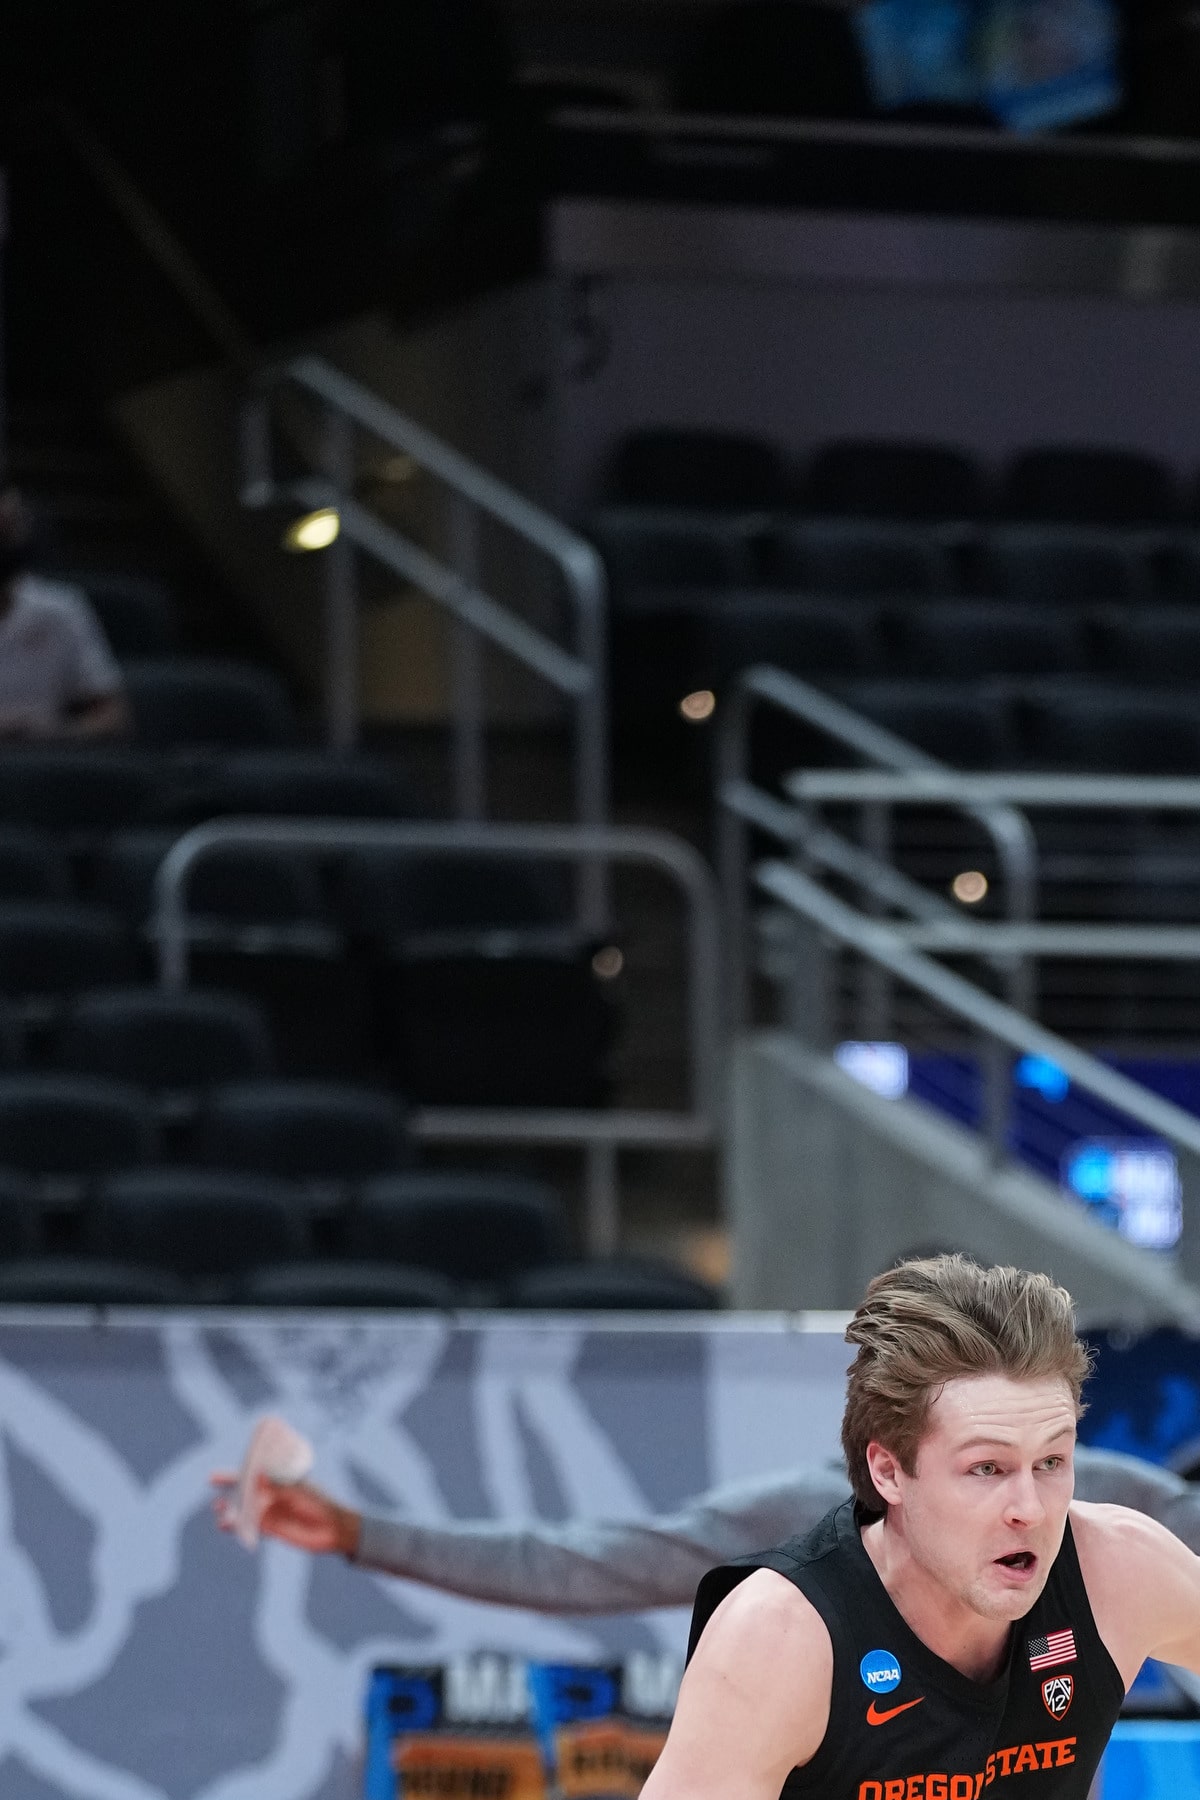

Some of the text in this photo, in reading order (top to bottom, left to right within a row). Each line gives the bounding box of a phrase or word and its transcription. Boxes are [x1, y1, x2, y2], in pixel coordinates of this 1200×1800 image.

[867, 1667, 900, 1684] NCAA
[1044, 1677, 1072, 1706] PAC
[1051, 1694, 1067, 1713] 12
[985, 1736, 1078, 1787] STATE
